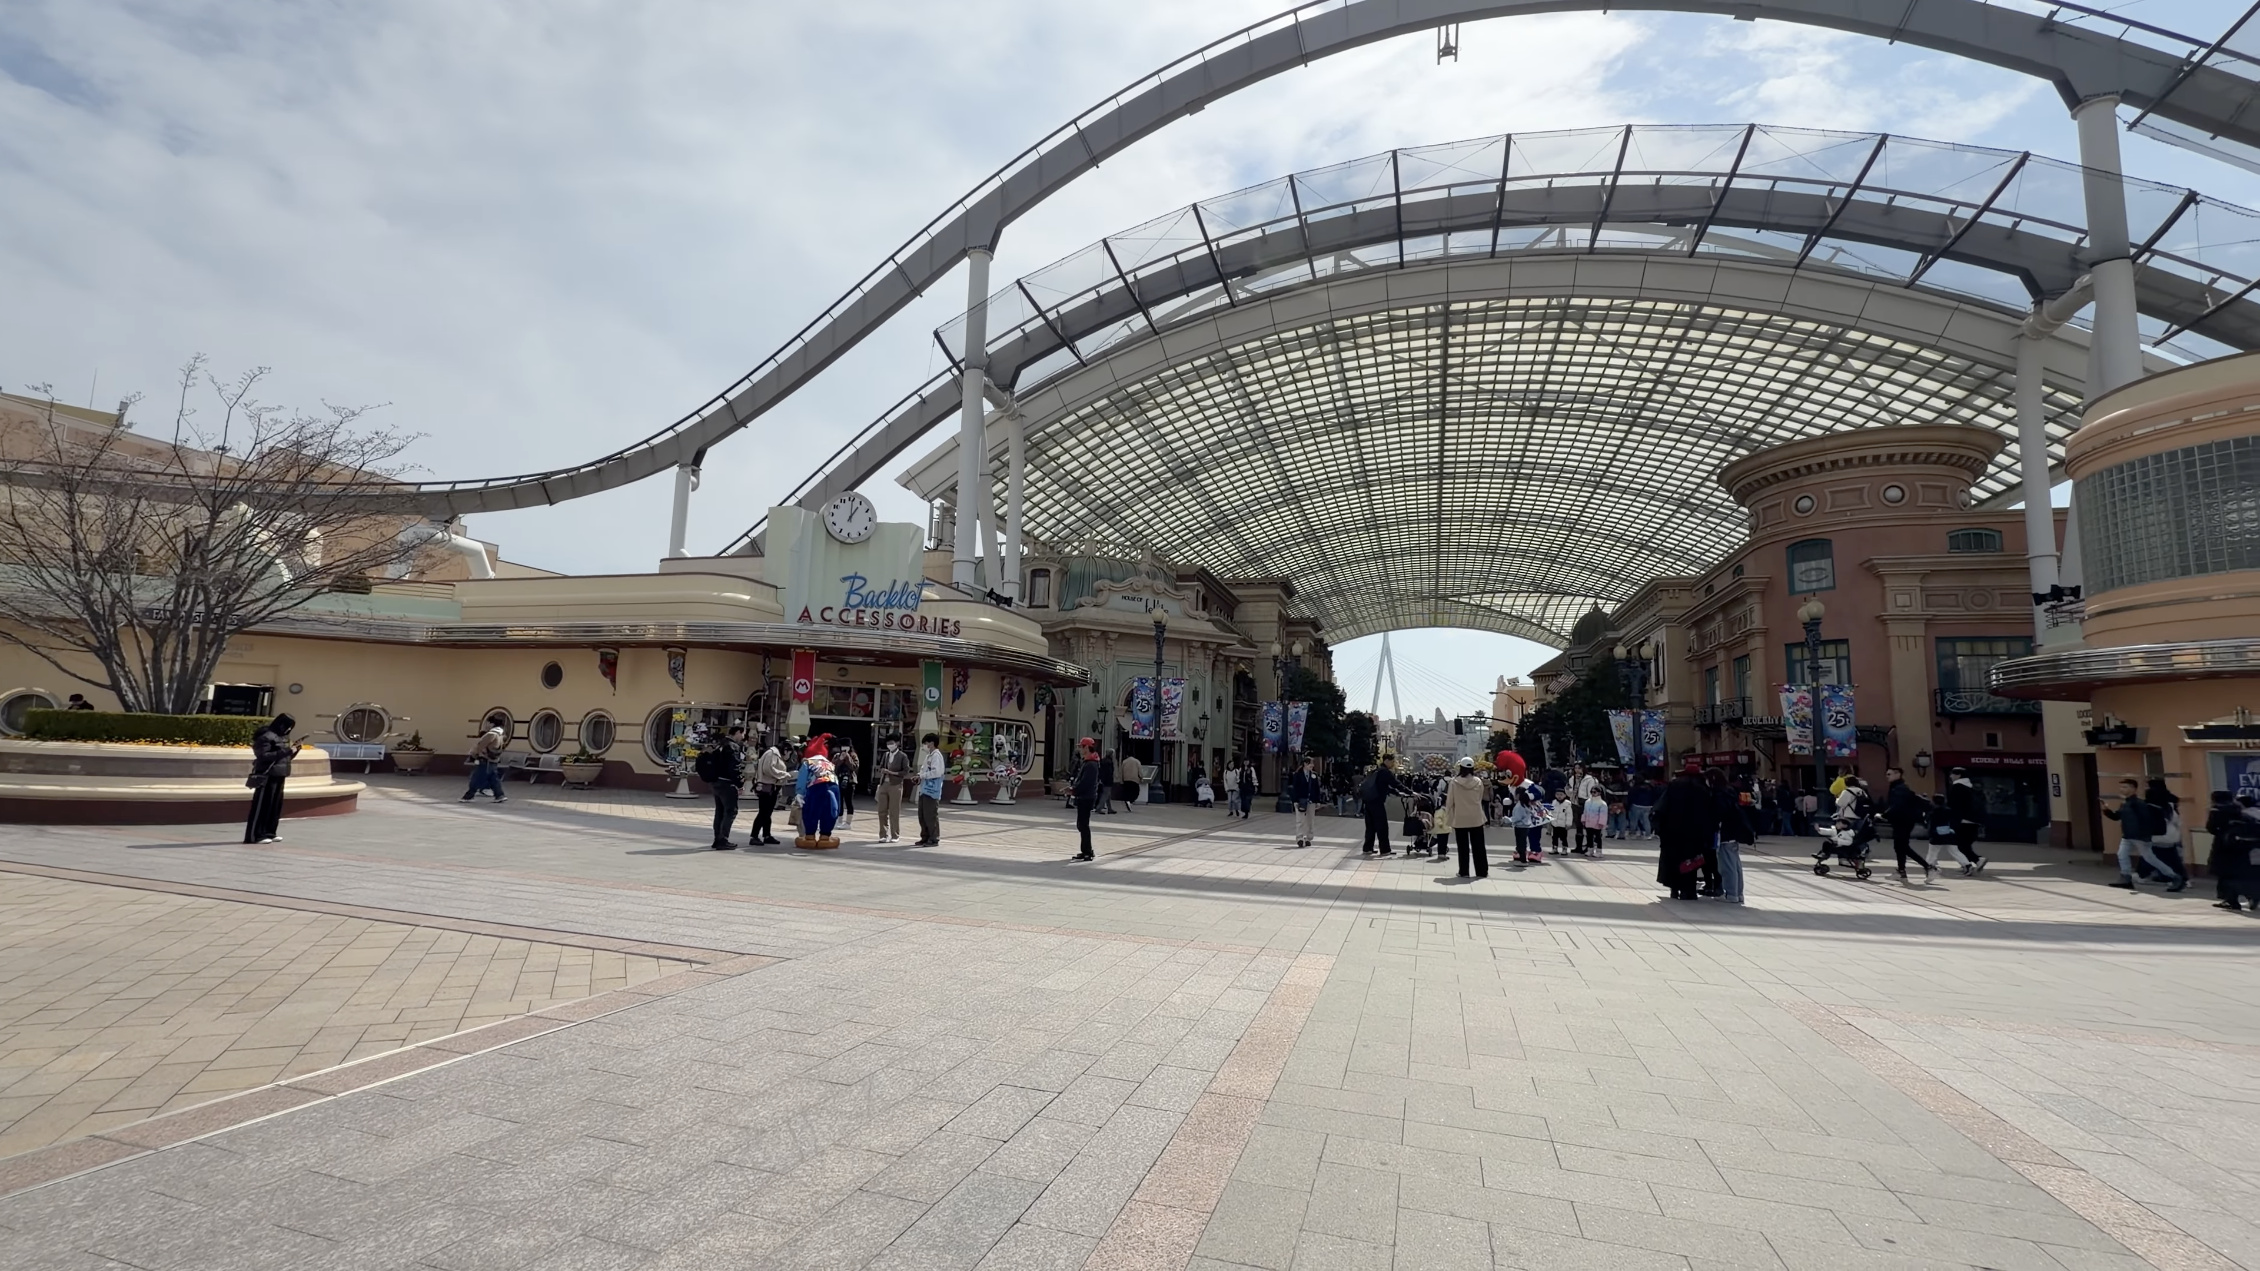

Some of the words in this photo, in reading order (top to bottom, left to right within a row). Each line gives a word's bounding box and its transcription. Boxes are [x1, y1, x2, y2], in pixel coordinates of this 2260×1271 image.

[839, 571, 936, 613] Backlot
[797, 604, 962, 637] ACCESSORIES
[796, 681, 809, 690] M
[928, 688, 936, 699] L
[1742, 715, 1780, 725] BEVERLY
